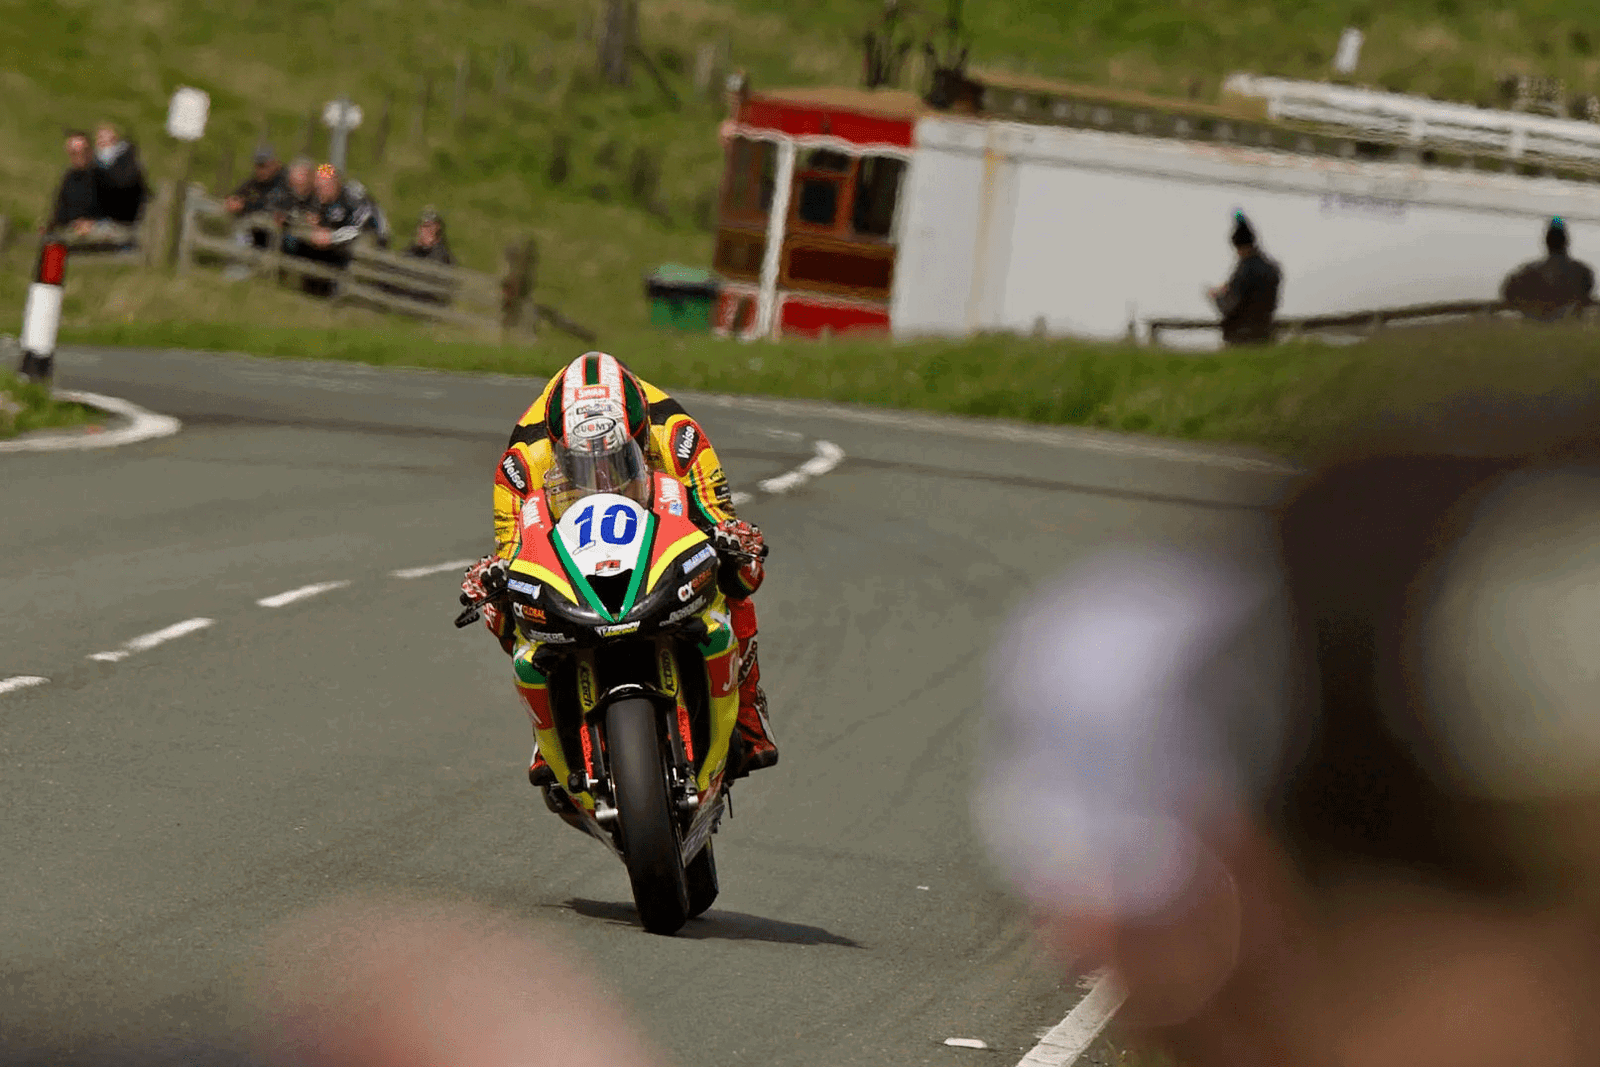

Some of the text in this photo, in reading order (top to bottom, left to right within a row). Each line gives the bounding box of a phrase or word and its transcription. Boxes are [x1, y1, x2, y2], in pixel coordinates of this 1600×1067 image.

[677, 425, 696, 460] Weise
[502, 456, 526, 489] Weise
[573, 504, 638, 551] 10
